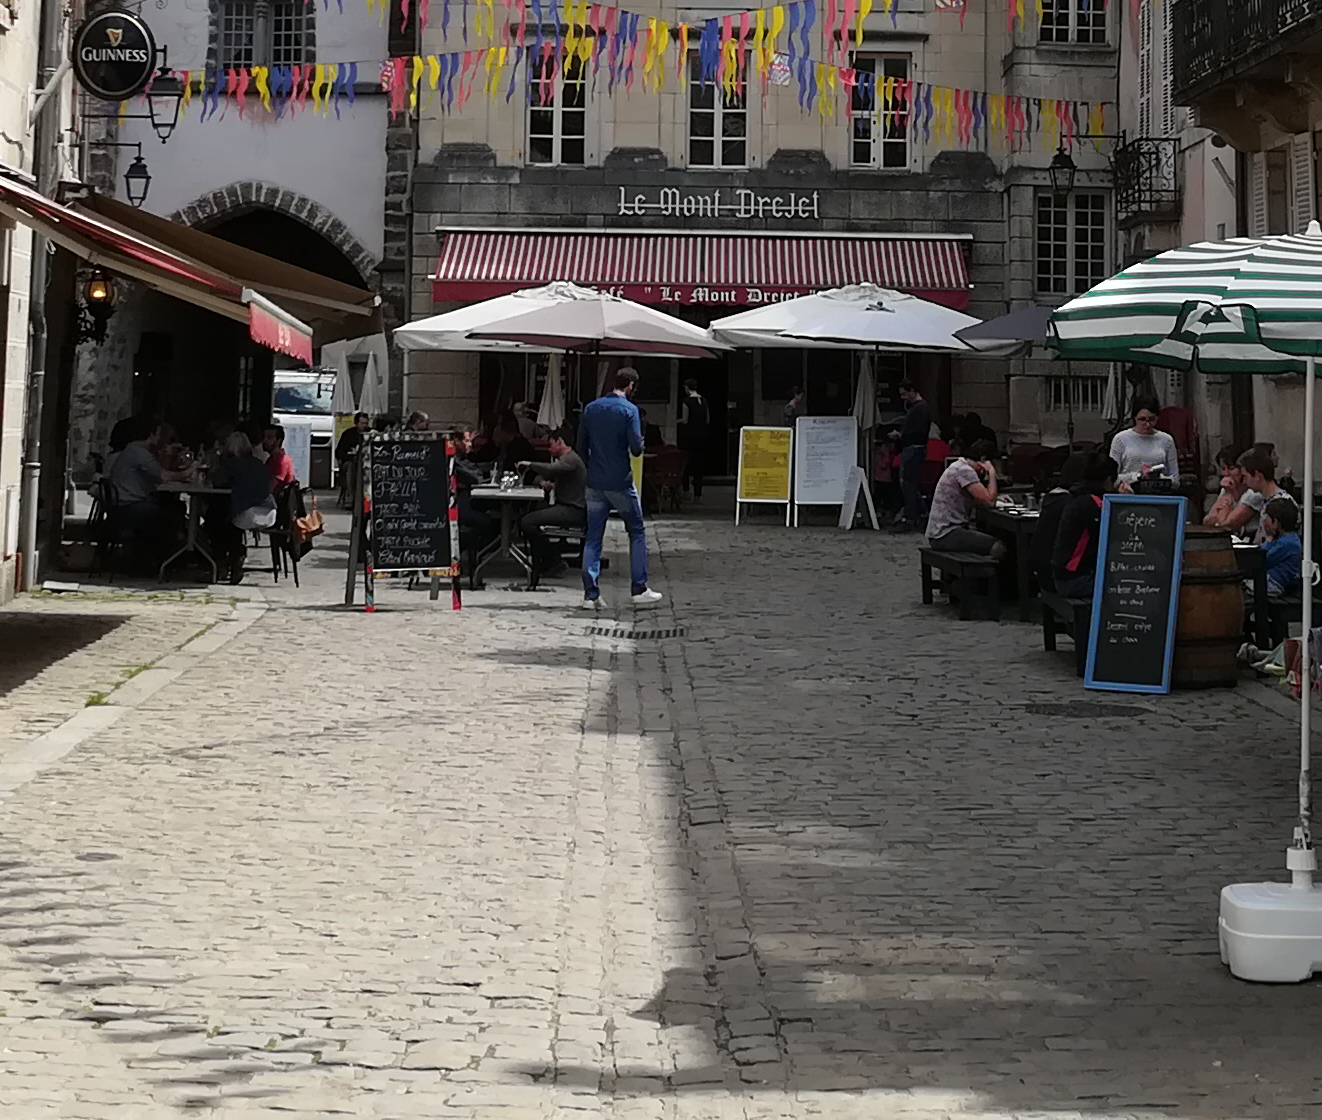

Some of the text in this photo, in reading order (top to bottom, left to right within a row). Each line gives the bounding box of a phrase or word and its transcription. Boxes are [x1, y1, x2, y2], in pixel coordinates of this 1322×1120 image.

[81, 46, 148, 63] GUINNESS
[618, 186, 646, 216] Le
[660, 187, 721, 217] Mont
[659, 286, 682, 301] Le
[689, 286, 737, 302] Mont
